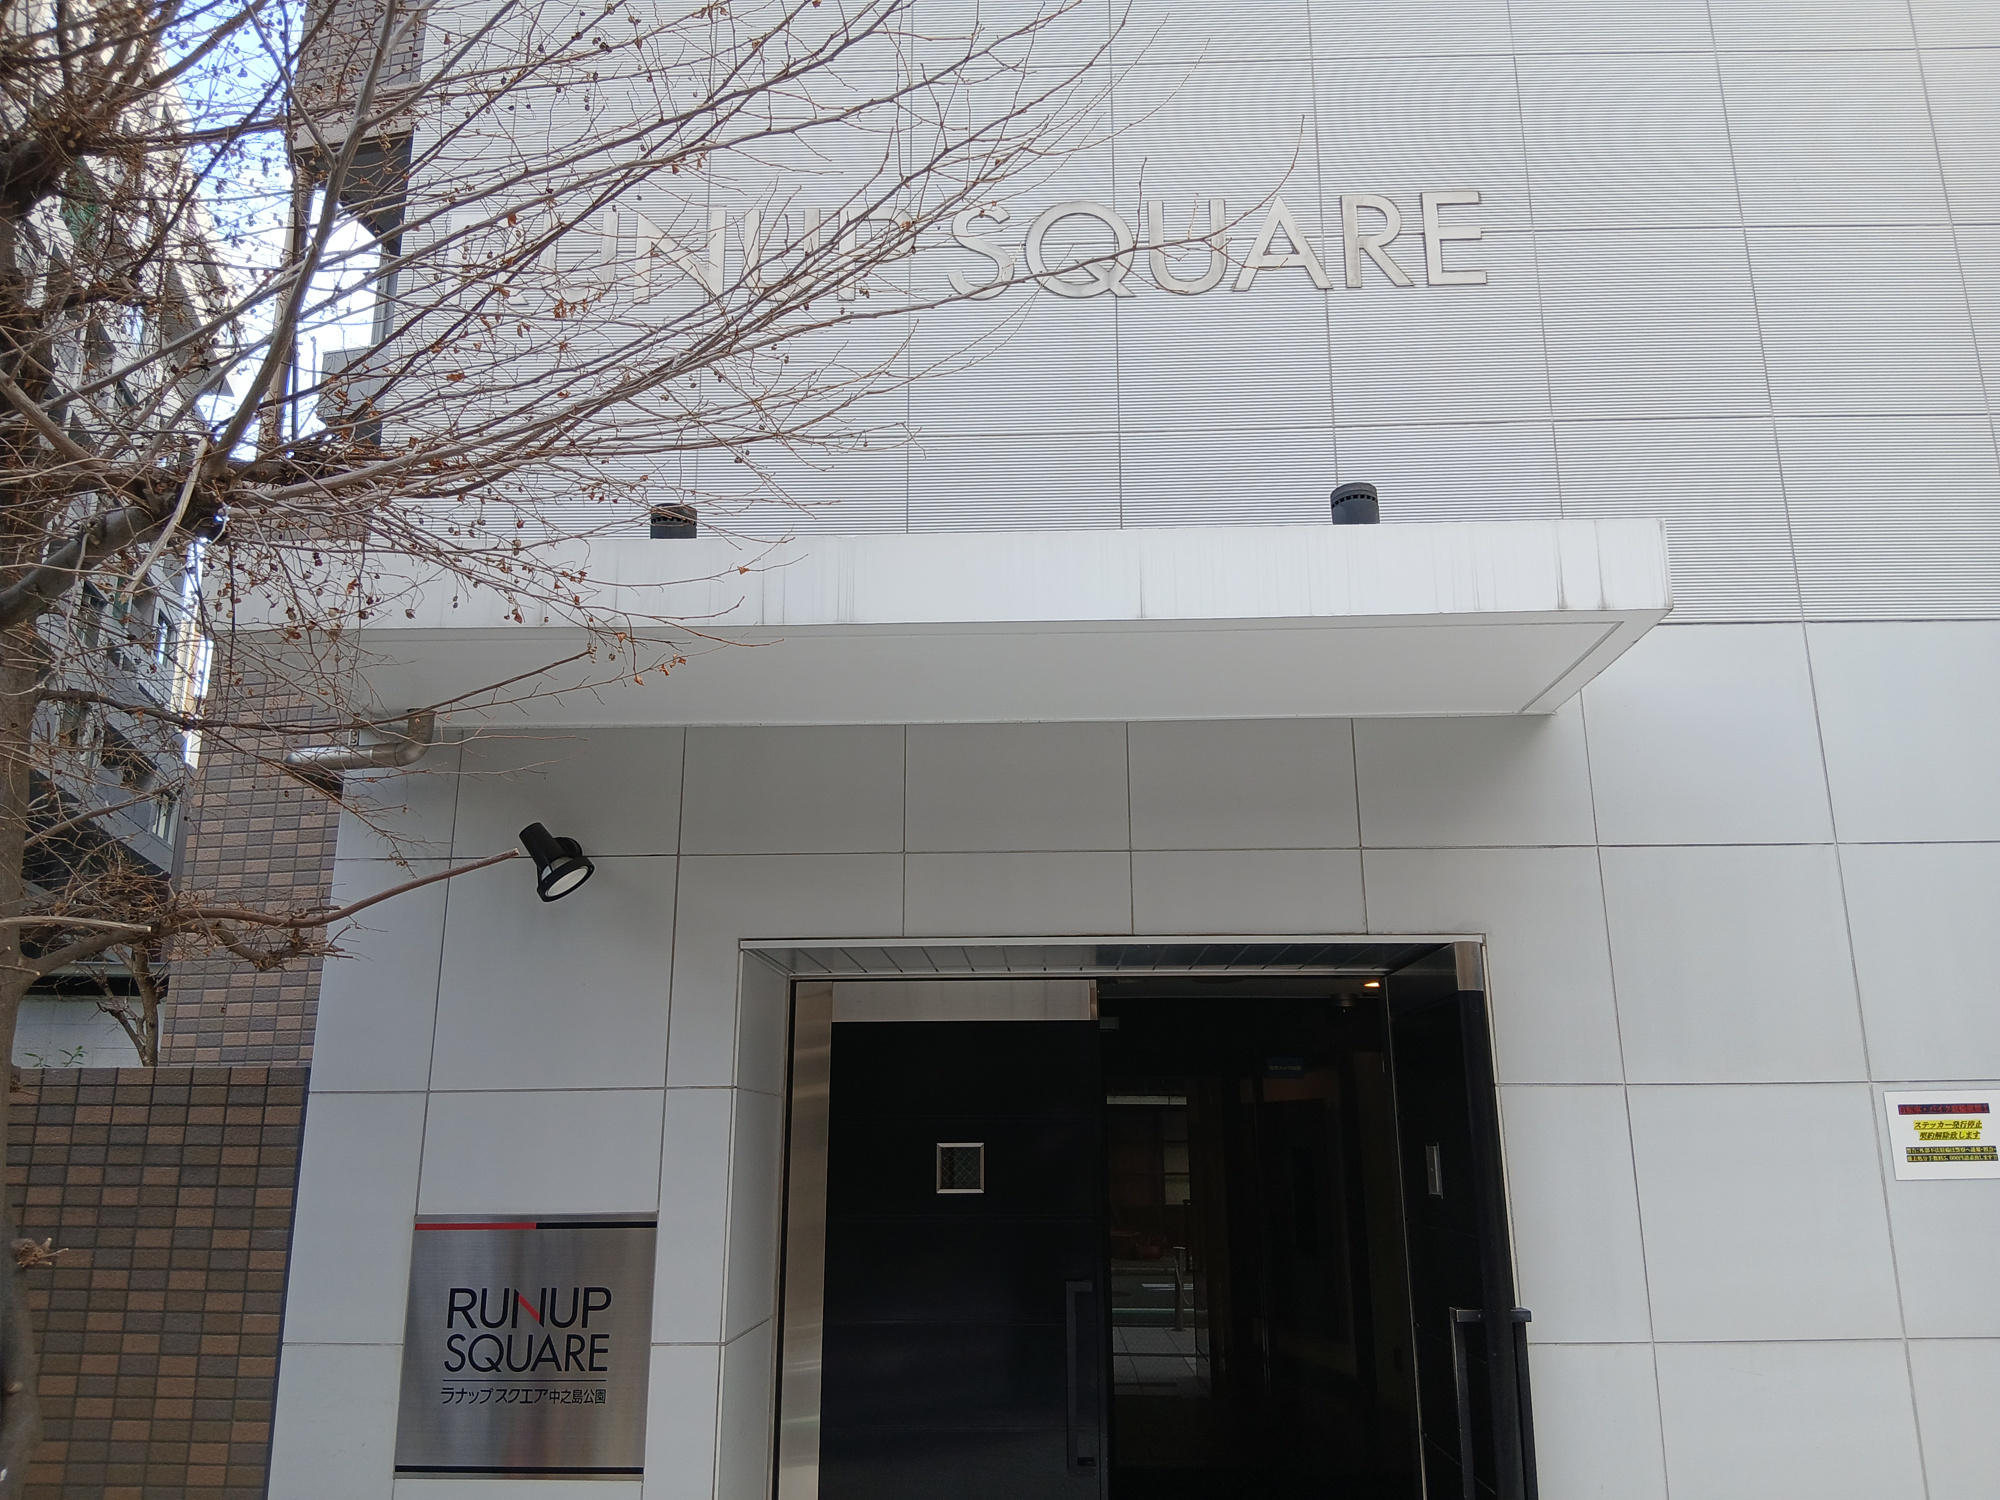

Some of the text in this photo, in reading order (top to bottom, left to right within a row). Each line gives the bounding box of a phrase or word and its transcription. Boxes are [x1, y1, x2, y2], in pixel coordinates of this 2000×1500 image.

[948, 191, 1489, 300] SQUARE
[446, 1286, 612, 1329] RUNUP
[444, 1333, 610, 1373] SQUARE
